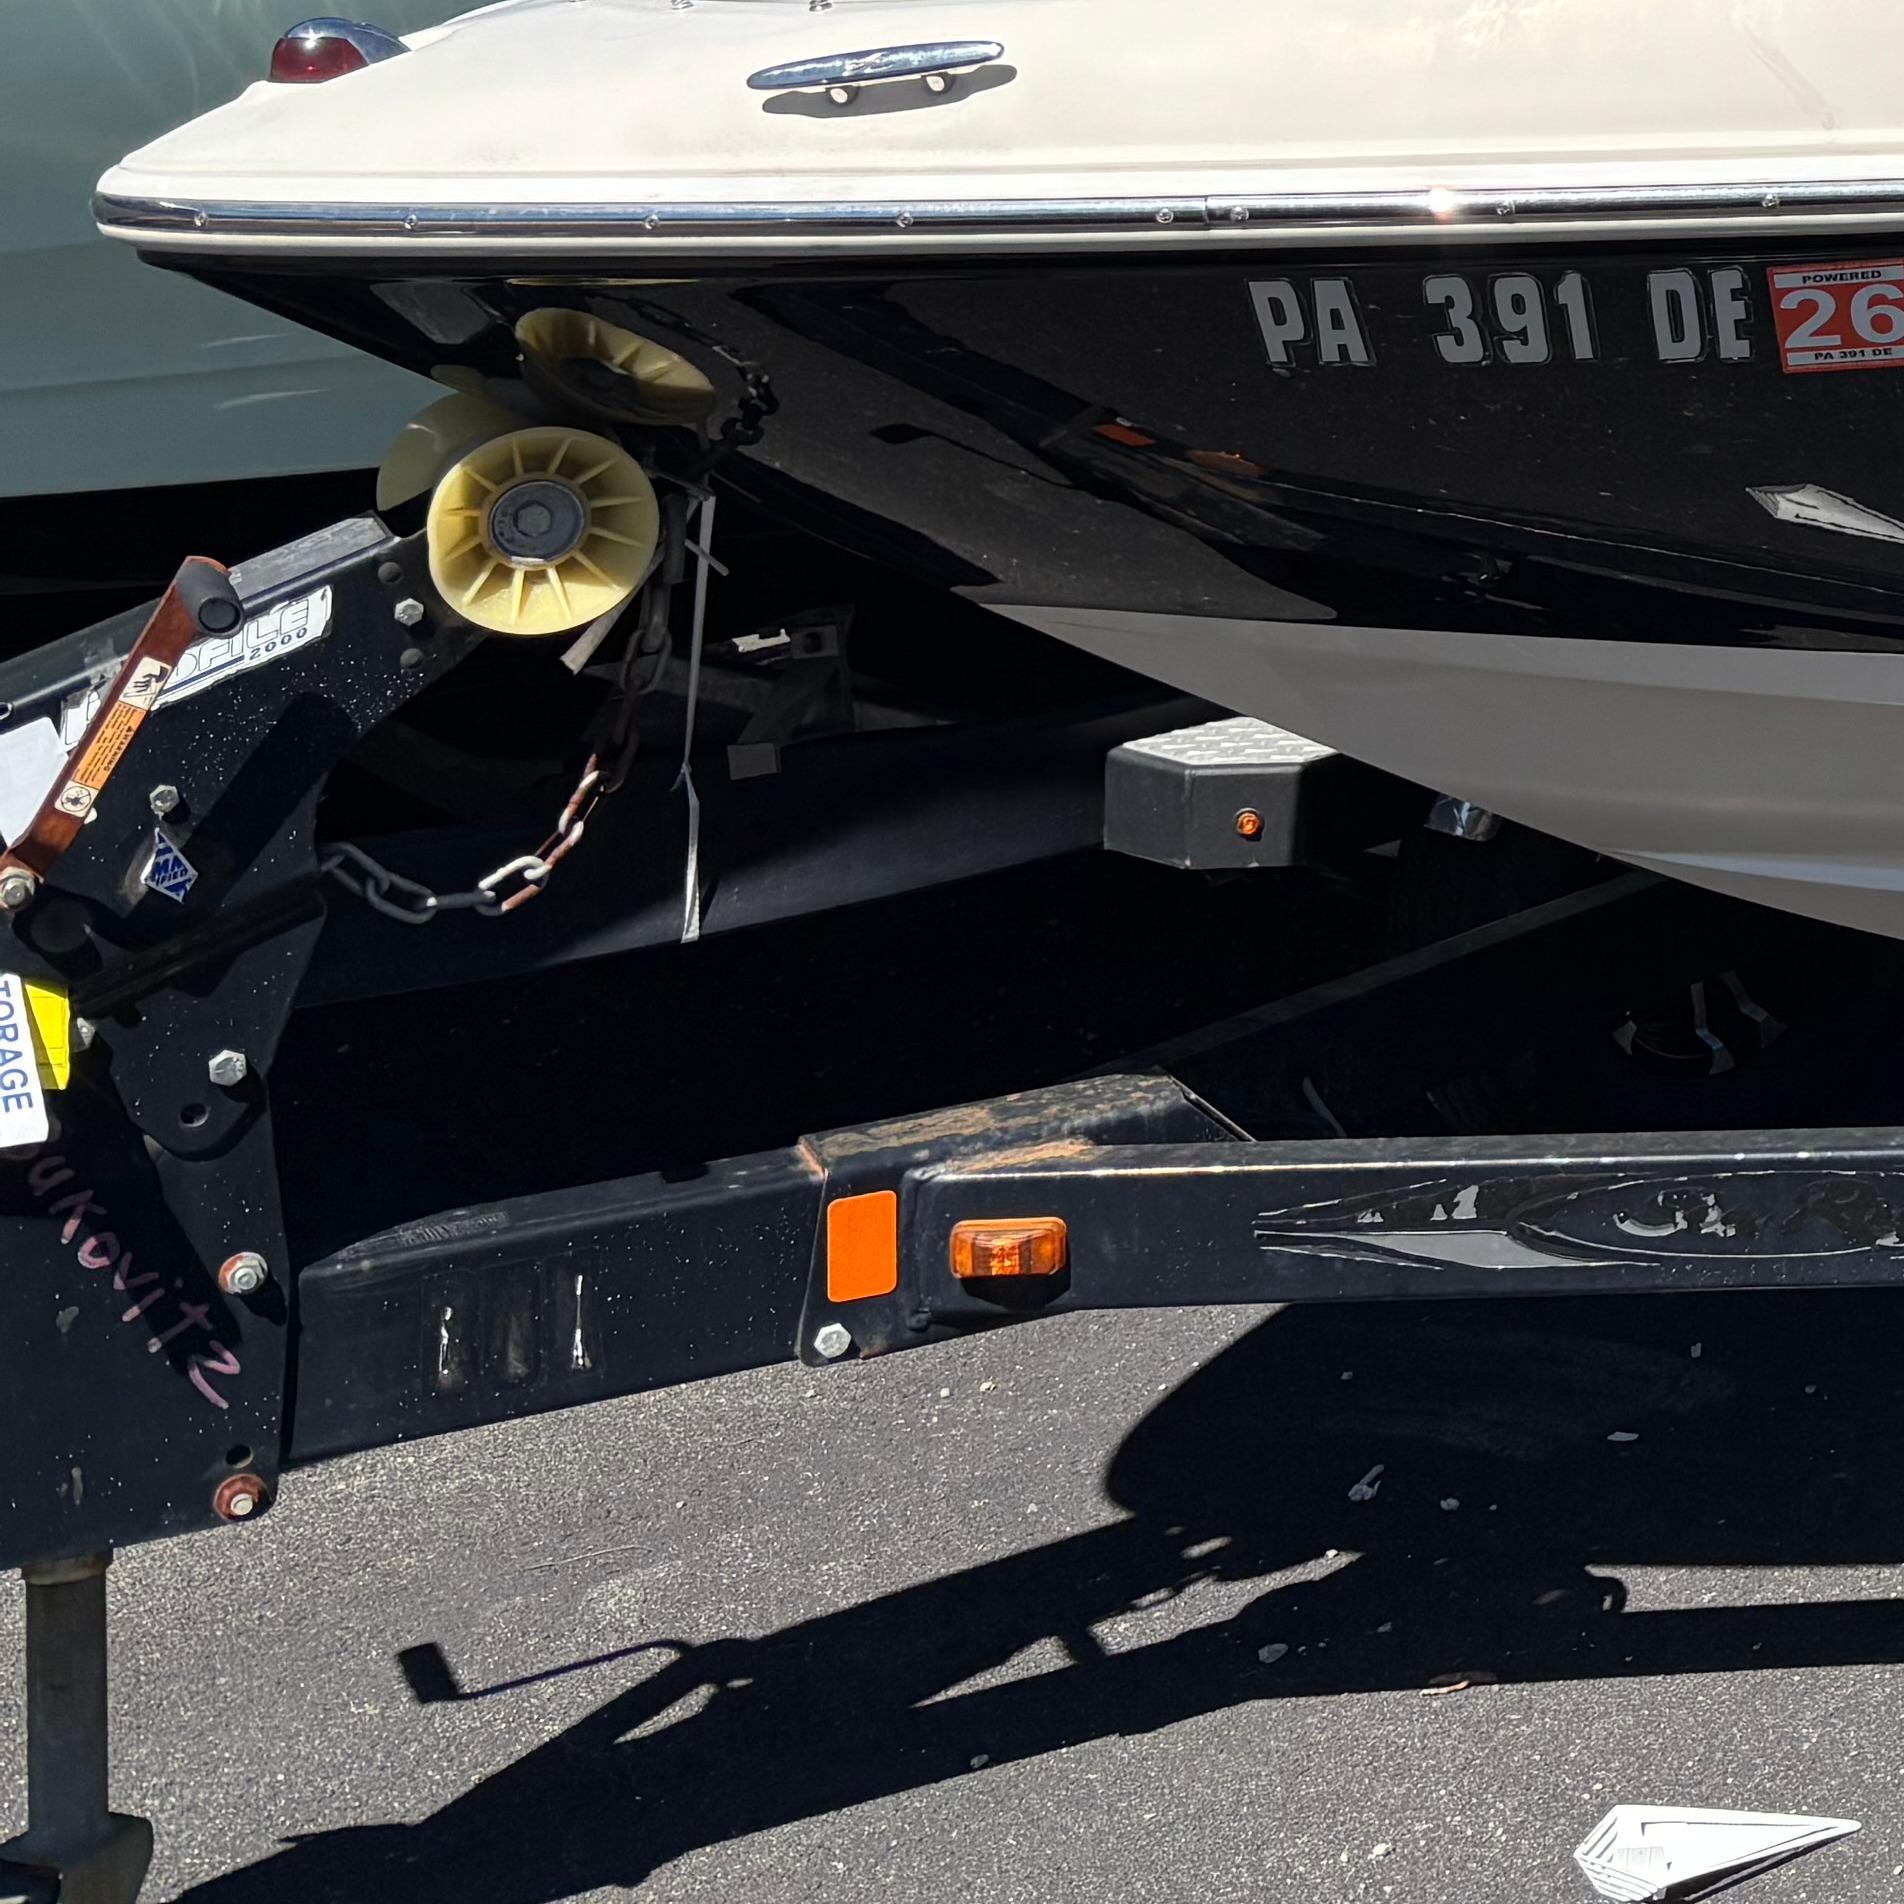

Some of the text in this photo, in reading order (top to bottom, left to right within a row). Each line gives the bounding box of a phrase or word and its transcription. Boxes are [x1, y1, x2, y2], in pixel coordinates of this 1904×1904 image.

[1801, 269, 1882, 285] POWERED
[1248, 266, 1753, 364] PA 391 DE
[1814, 347, 1893, 361] PA 391 DE
[249, 626, 309, 662] 2000
